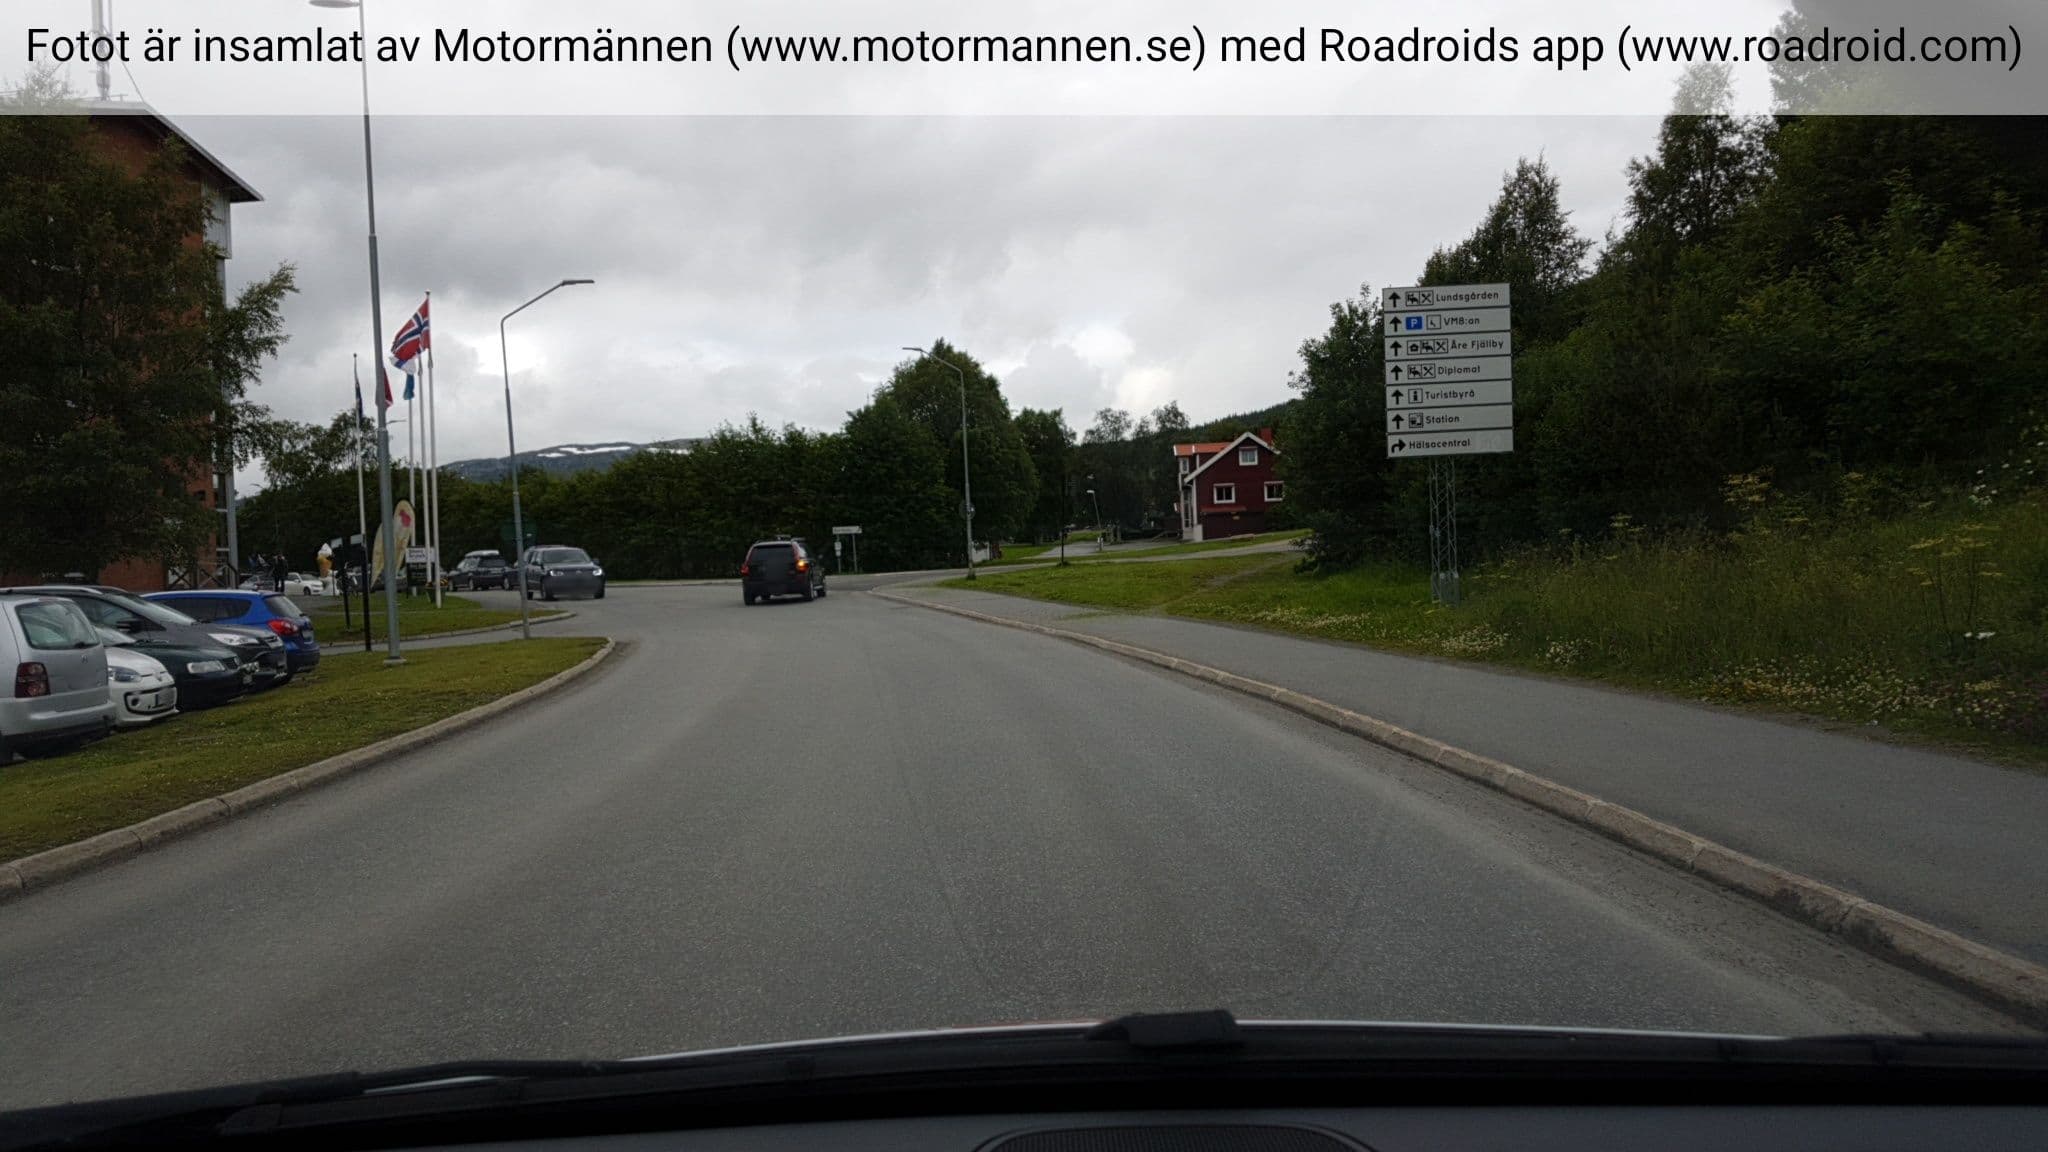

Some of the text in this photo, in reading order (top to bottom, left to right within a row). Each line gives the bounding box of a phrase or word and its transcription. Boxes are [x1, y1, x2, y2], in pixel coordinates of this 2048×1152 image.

[1436, 292, 1499, 302] Lundsgården
[1450, 339, 1504, 351] Åre Fjällby
[1437, 365, 1480, 376] Diplomat
[1425, 390, 1475, 400] Turistbyrå
[1425, 415, 1460, 424] Station
